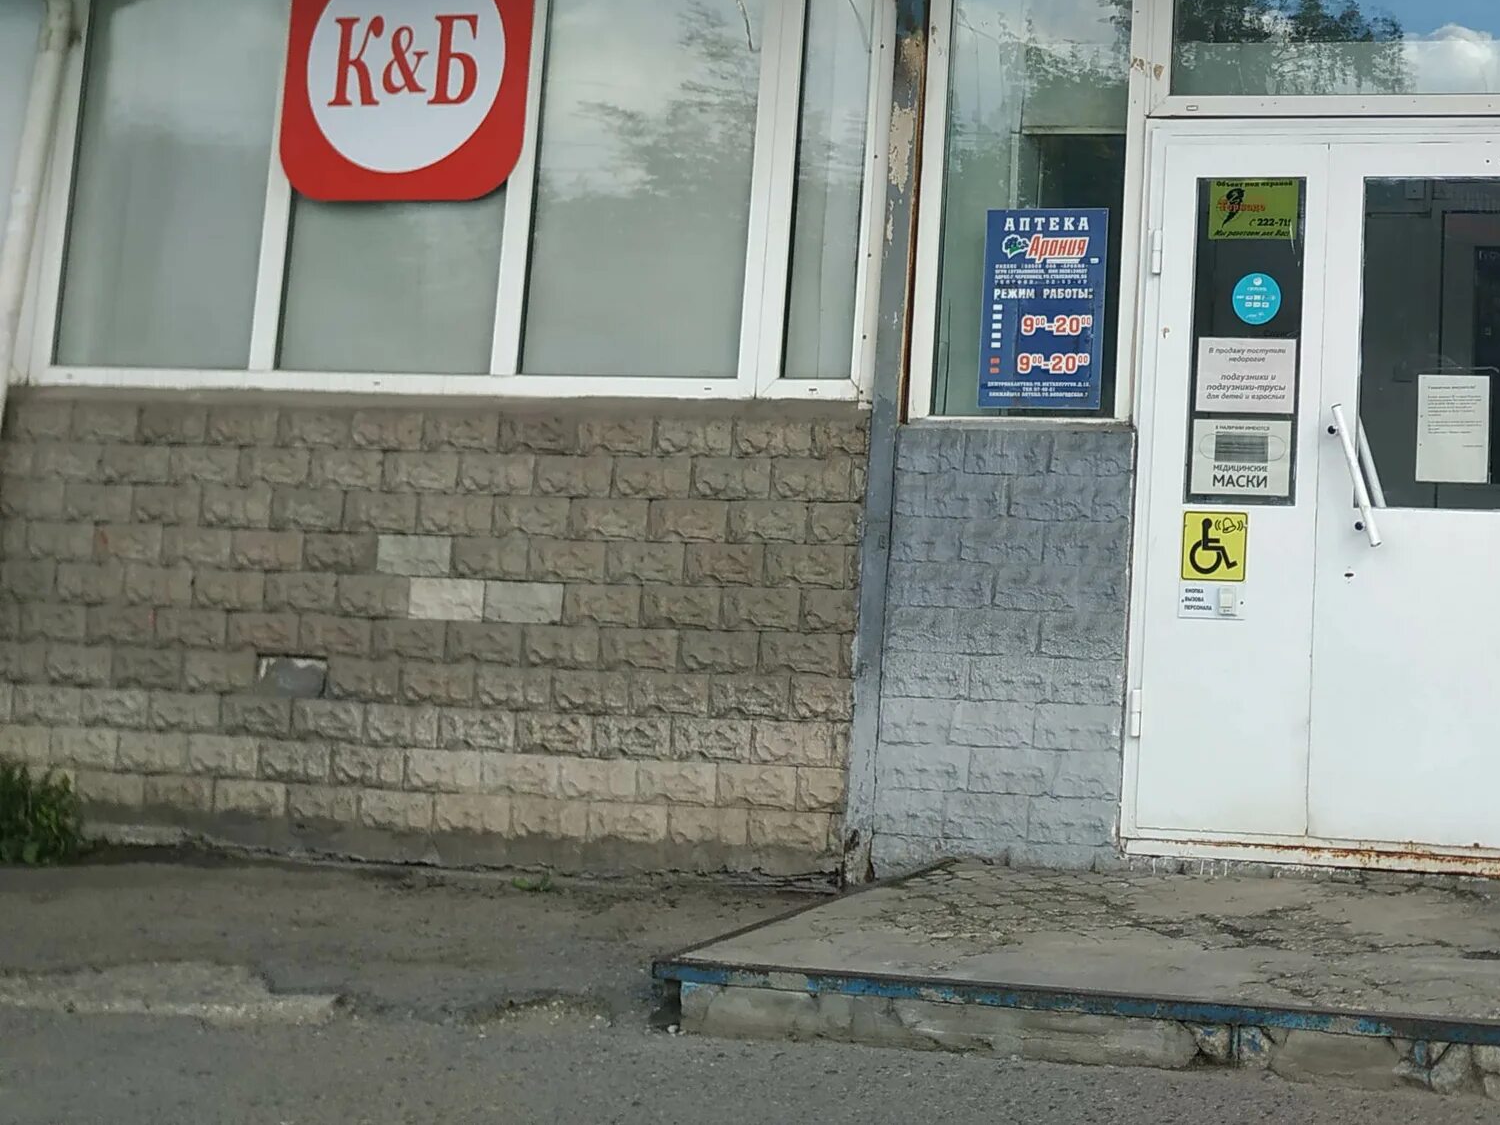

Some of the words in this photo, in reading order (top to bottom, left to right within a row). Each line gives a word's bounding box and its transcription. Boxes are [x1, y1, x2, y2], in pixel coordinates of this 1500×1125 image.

[327, 14, 478, 107] К&Б
[1004, 216, 1090, 232] АПТЕКА
[1026, 234, 1089, 262] Арония
[994, 287, 1036, 300] РЕЖИМ
[1042, 287, 1094, 300] РАБОТЫ:
[1215, 347, 1246, 355] продажу
[1220, 373, 1269, 382] подгузники
[1206, 383, 1286, 392] подгузники-трусы
[1213, 464, 1269, 473] МЕДИЦИНСКИЕ
[1212, 474, 1268, 488] МАСКИ
